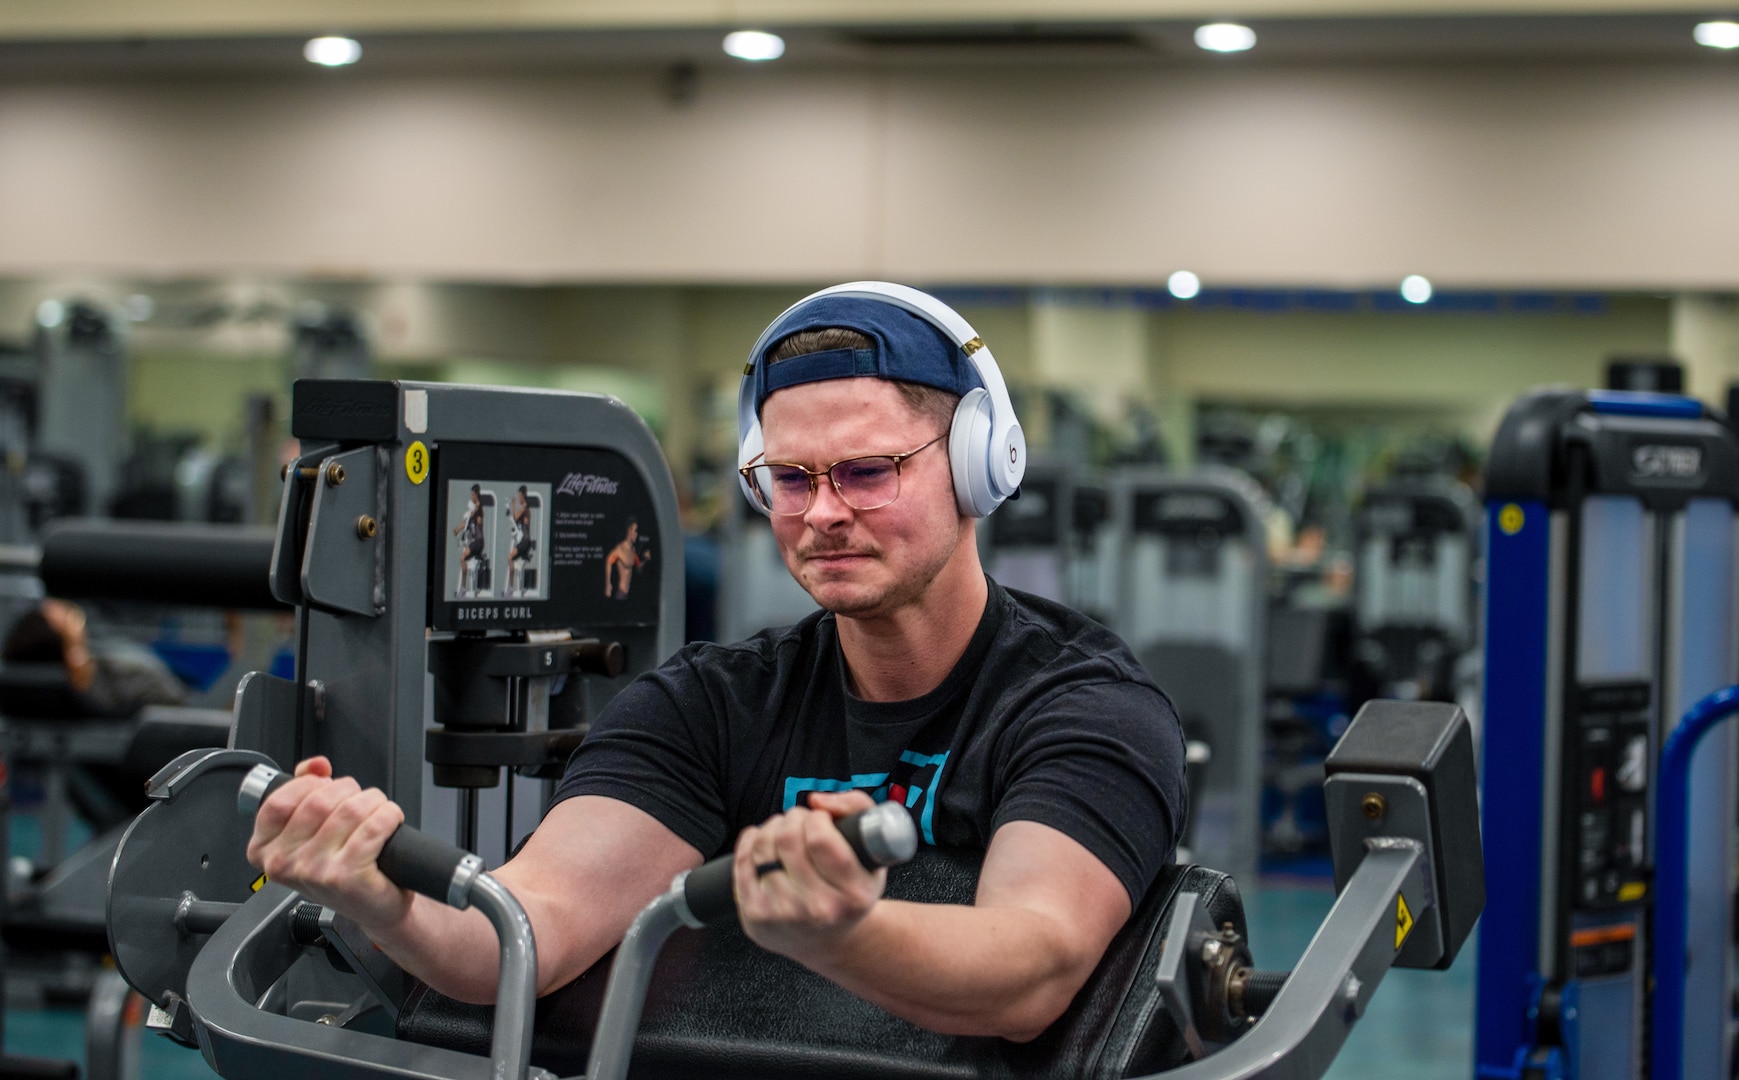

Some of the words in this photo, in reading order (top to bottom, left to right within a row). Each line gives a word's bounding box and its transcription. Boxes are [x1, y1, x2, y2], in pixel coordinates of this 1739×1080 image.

[413, 449, 423, 474] 3
[458, 607, 499, 620] BICEPS
[504, 606, 533, 619] CURL
[544, 651, 553, 666] 5
